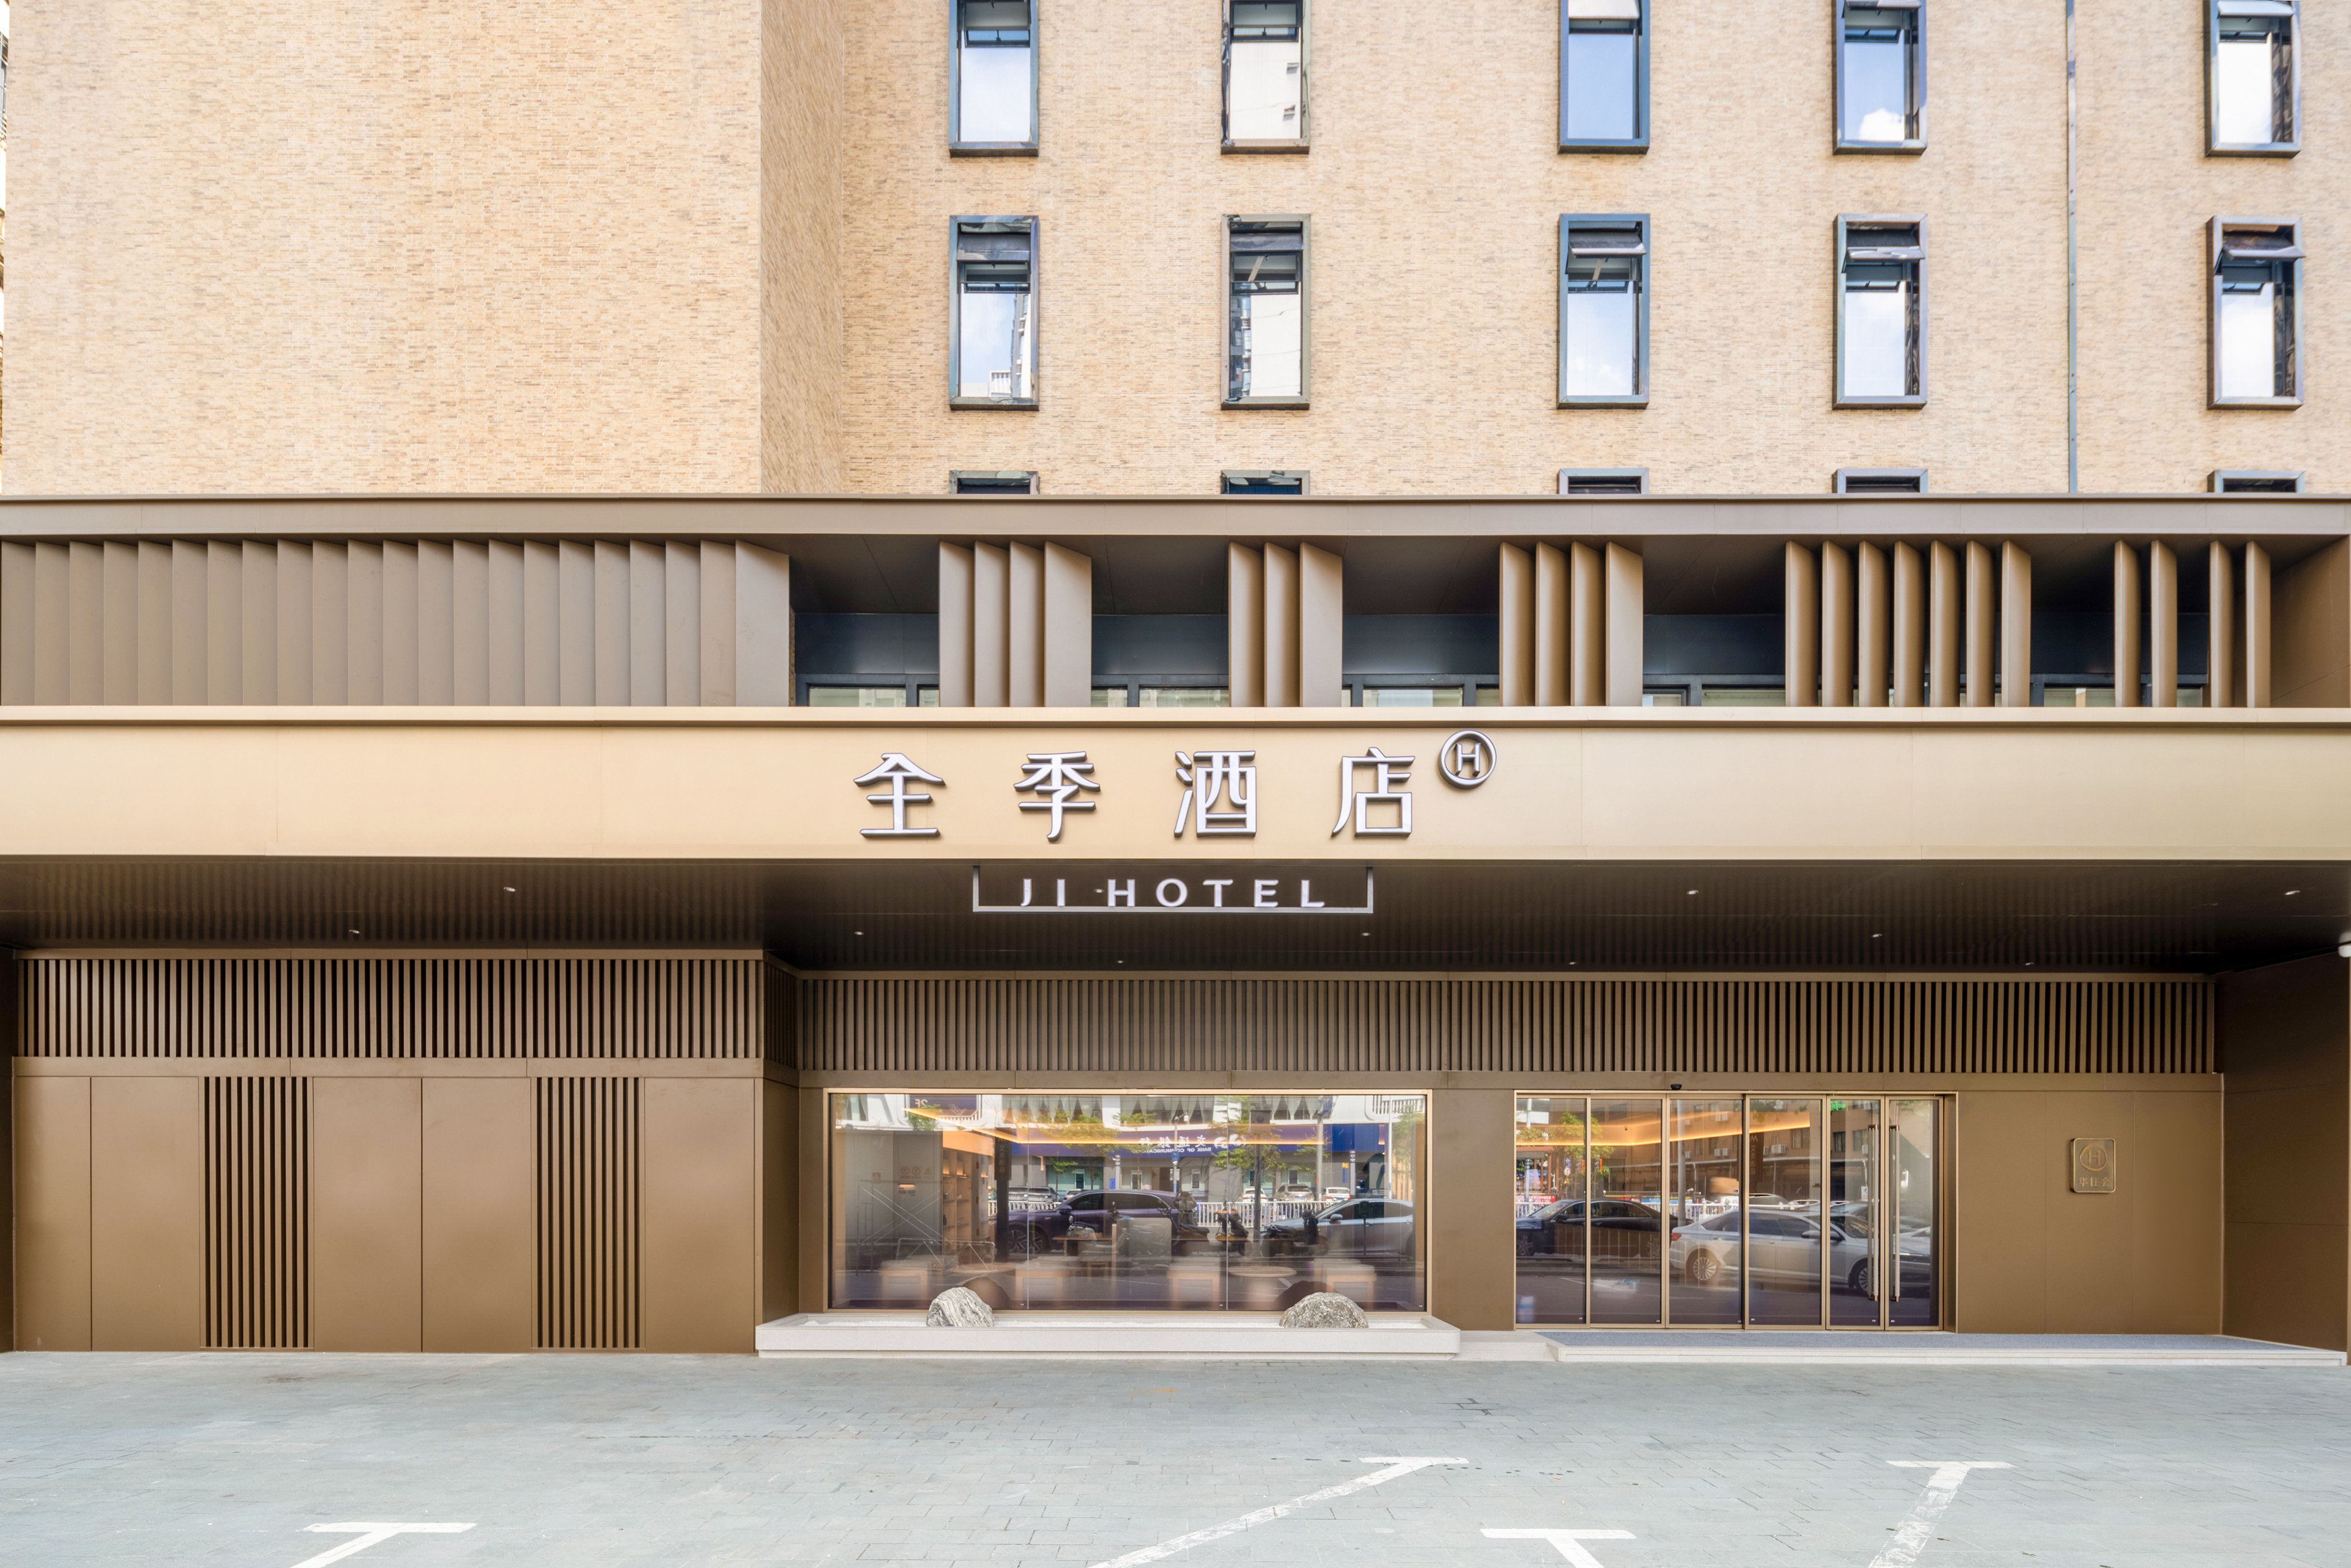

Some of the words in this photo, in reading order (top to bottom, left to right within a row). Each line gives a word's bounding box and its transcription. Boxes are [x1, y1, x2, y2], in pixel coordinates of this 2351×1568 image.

[853, 747, 1415, 842] 全季酒店
[1021, 879, 1067, 908] JI
[1107, 879, 1325, 908] HOTEL
[2078, 1176, 2110, 1187] 华住会
